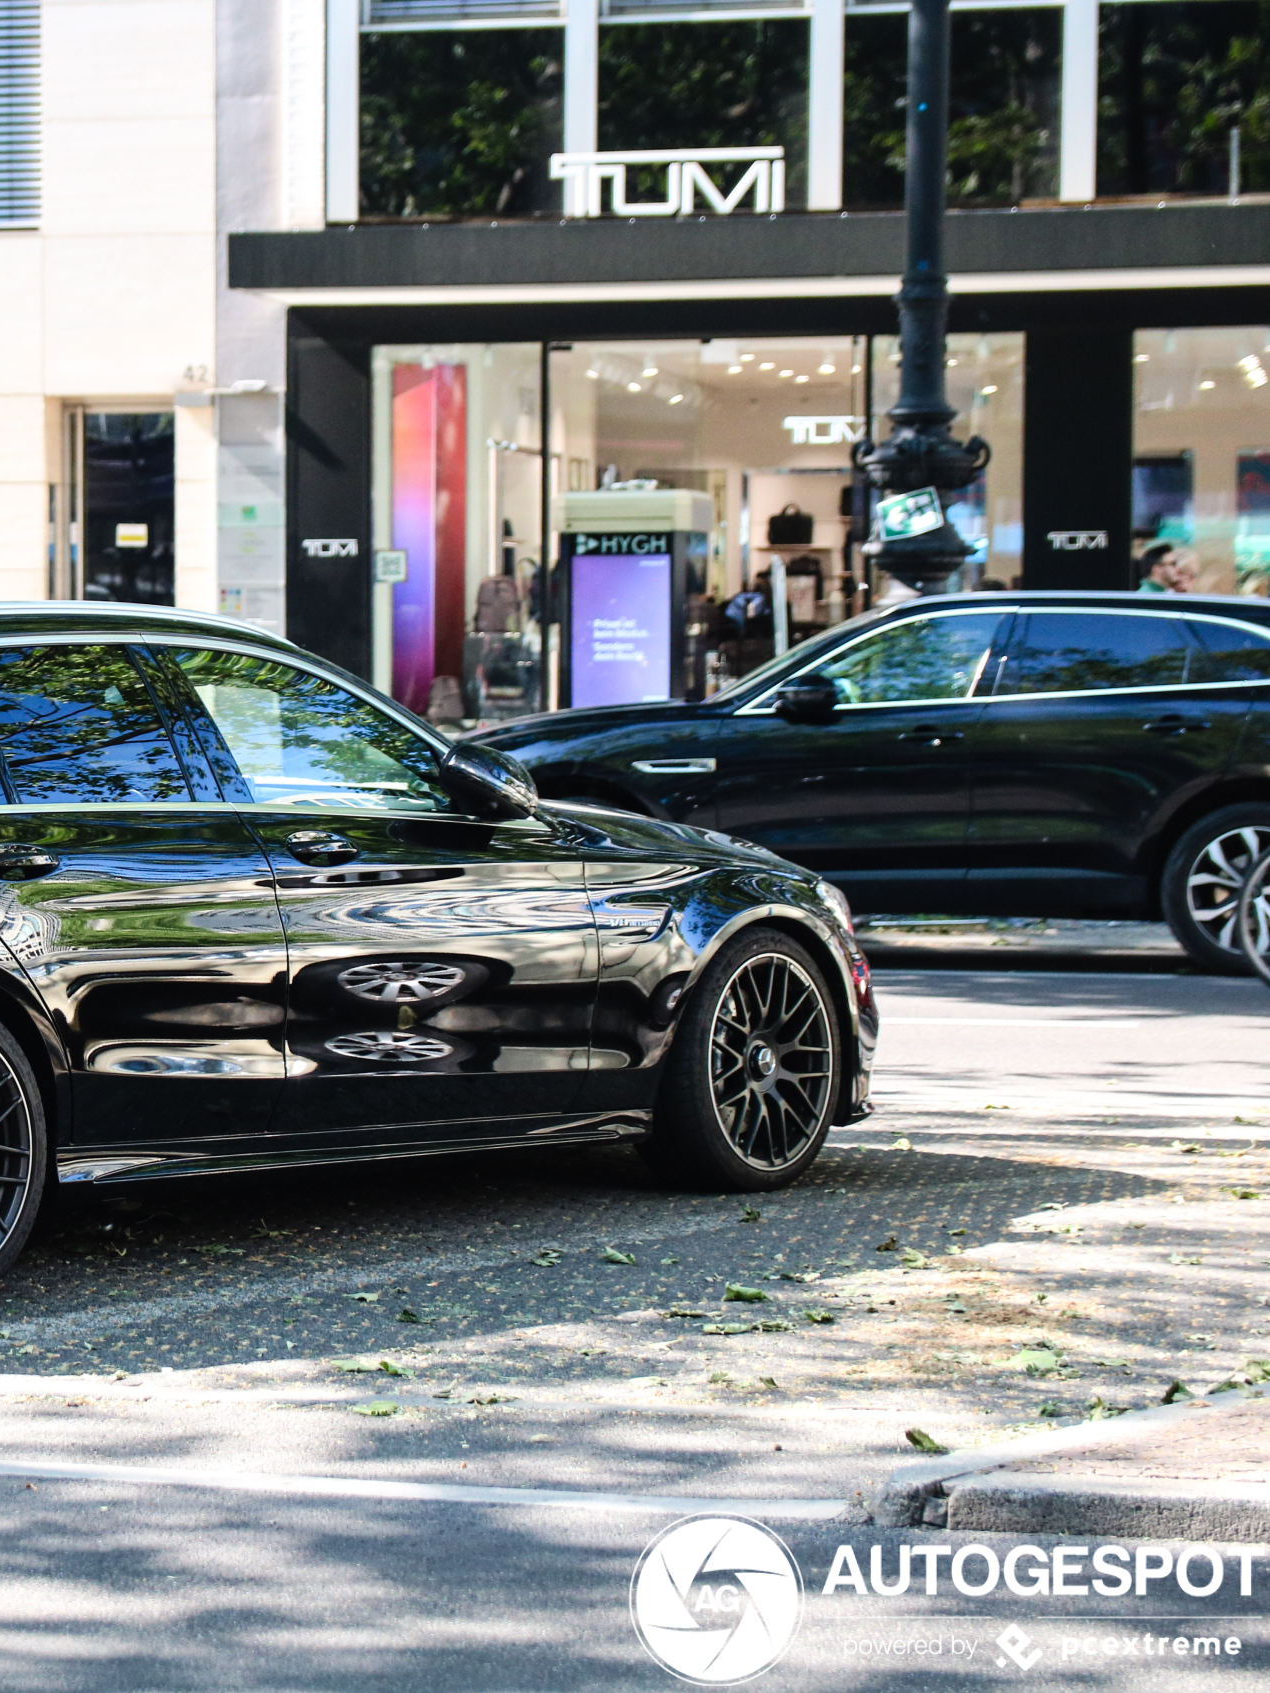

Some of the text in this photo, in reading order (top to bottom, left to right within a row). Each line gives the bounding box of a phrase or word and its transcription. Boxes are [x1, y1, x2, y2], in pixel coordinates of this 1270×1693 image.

[550, 146, 786, 217] TUMI
[183, 364, 208, 382] 42
[302, 538, 358, 557] TUMI
[601, 535, 667, 553] HYGH
[1047, 531, 1108, 549] TUMI
